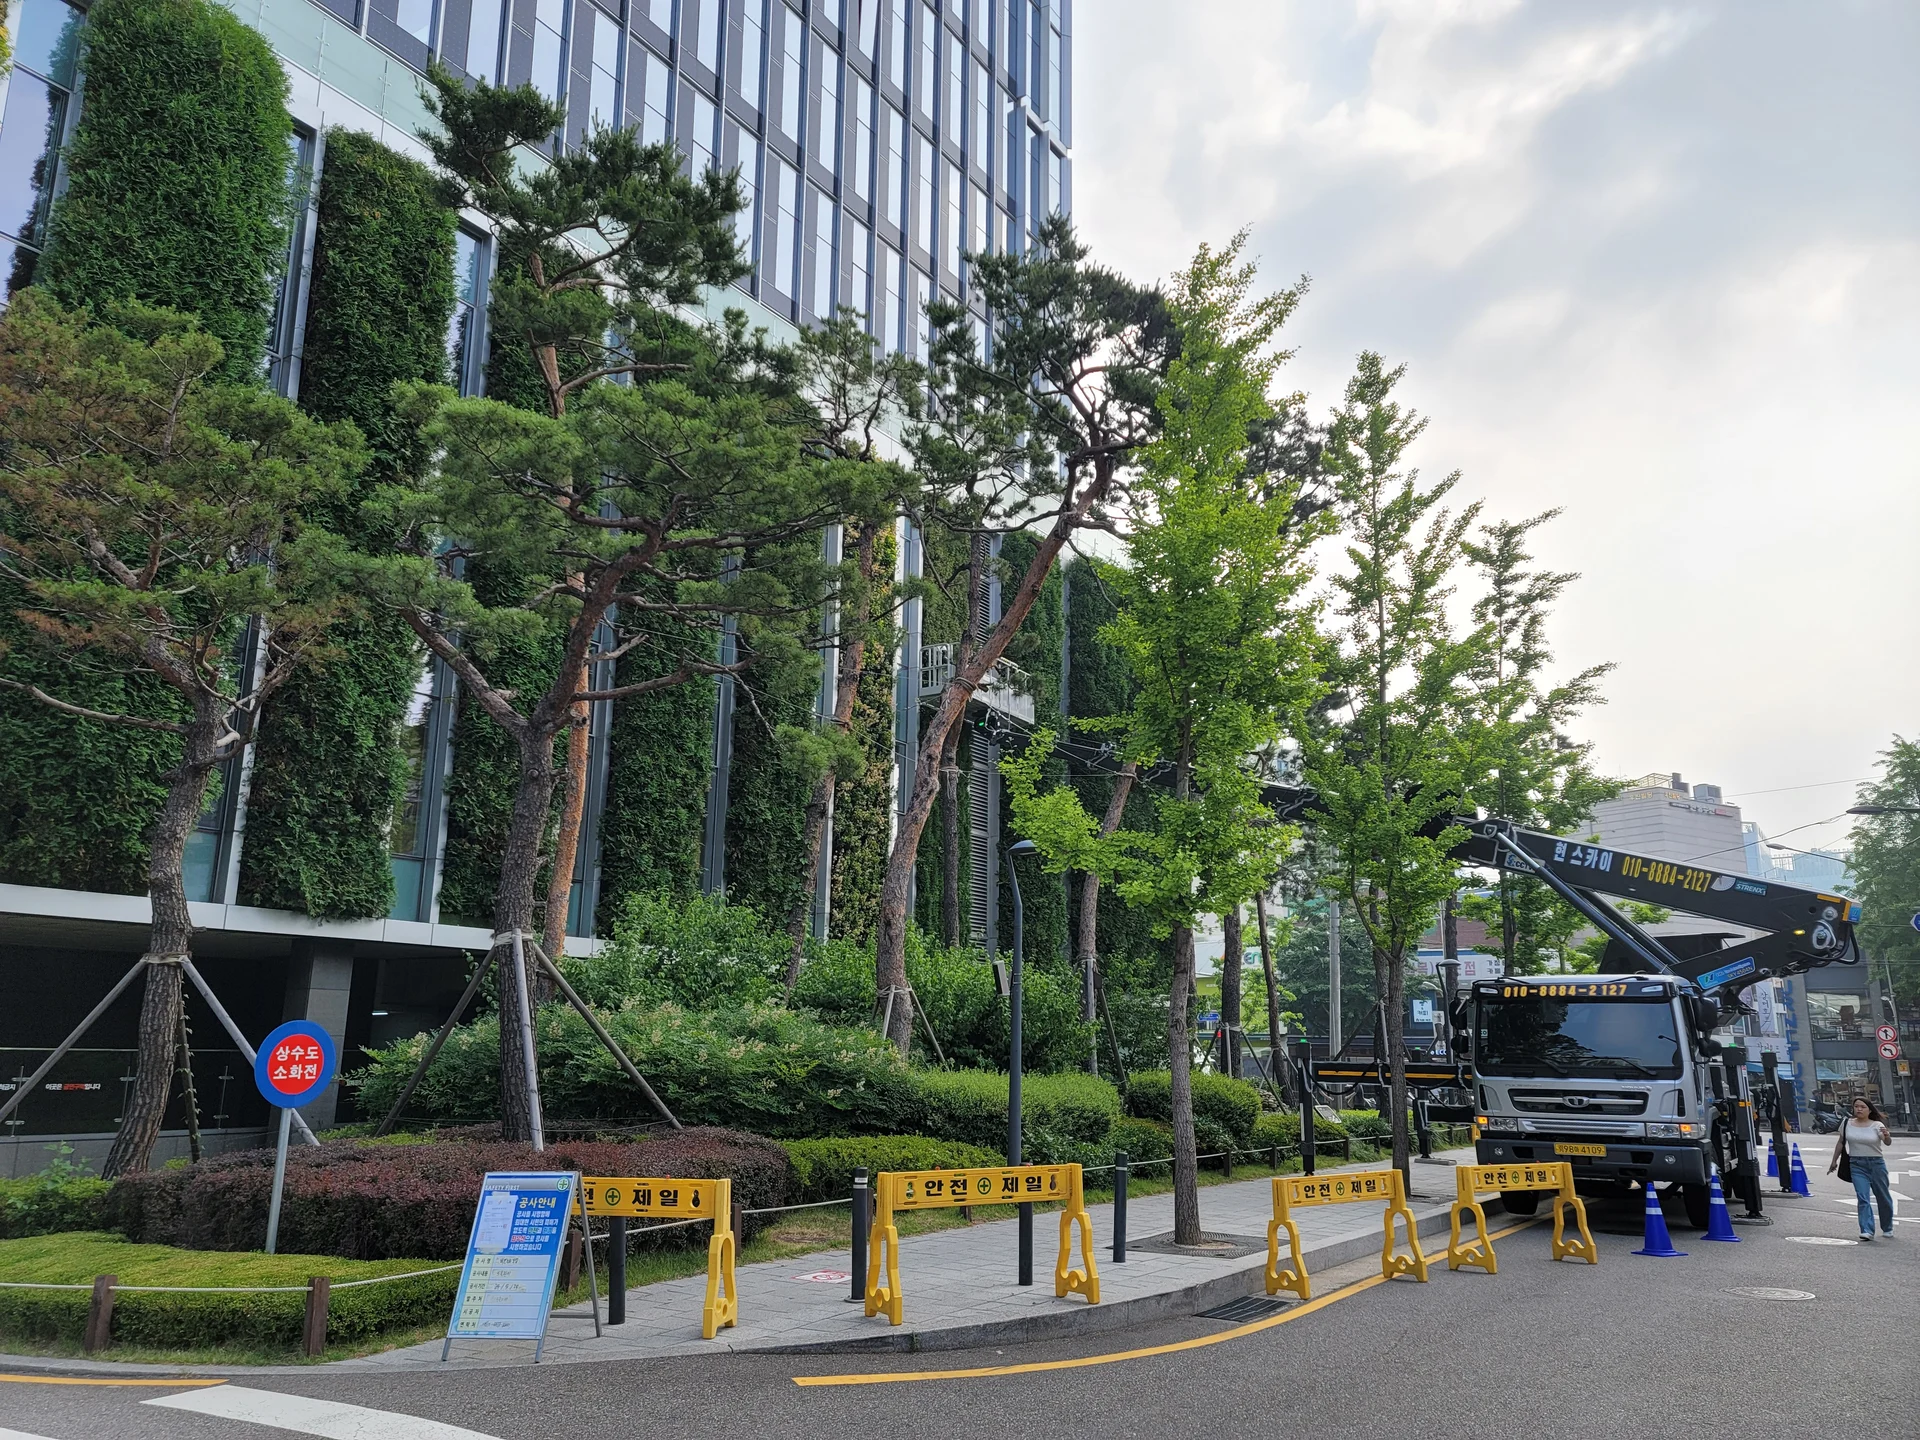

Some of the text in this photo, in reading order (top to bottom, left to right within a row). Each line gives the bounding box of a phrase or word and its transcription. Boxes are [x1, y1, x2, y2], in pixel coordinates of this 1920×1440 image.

[1570, 845, 1613, 872] 스카이
[1622, 856, 1712, 892] 010-8884-2127
[1504, 984, 1627, 998] 010-8884-2127
[275, 1045, 319, 1061] 상수도
[273, 1063, 317, 1080] 소화전
[924, 1175, 1042, 1197] 안전 제일
[1484, 1171, 1547, 1184] 안전 제일
[632, 1188, 678, 1207] 제일
[1304, 1179, 1376, 1198] 안전 제일
[519, 1197, 557, 1209] 공사안내
